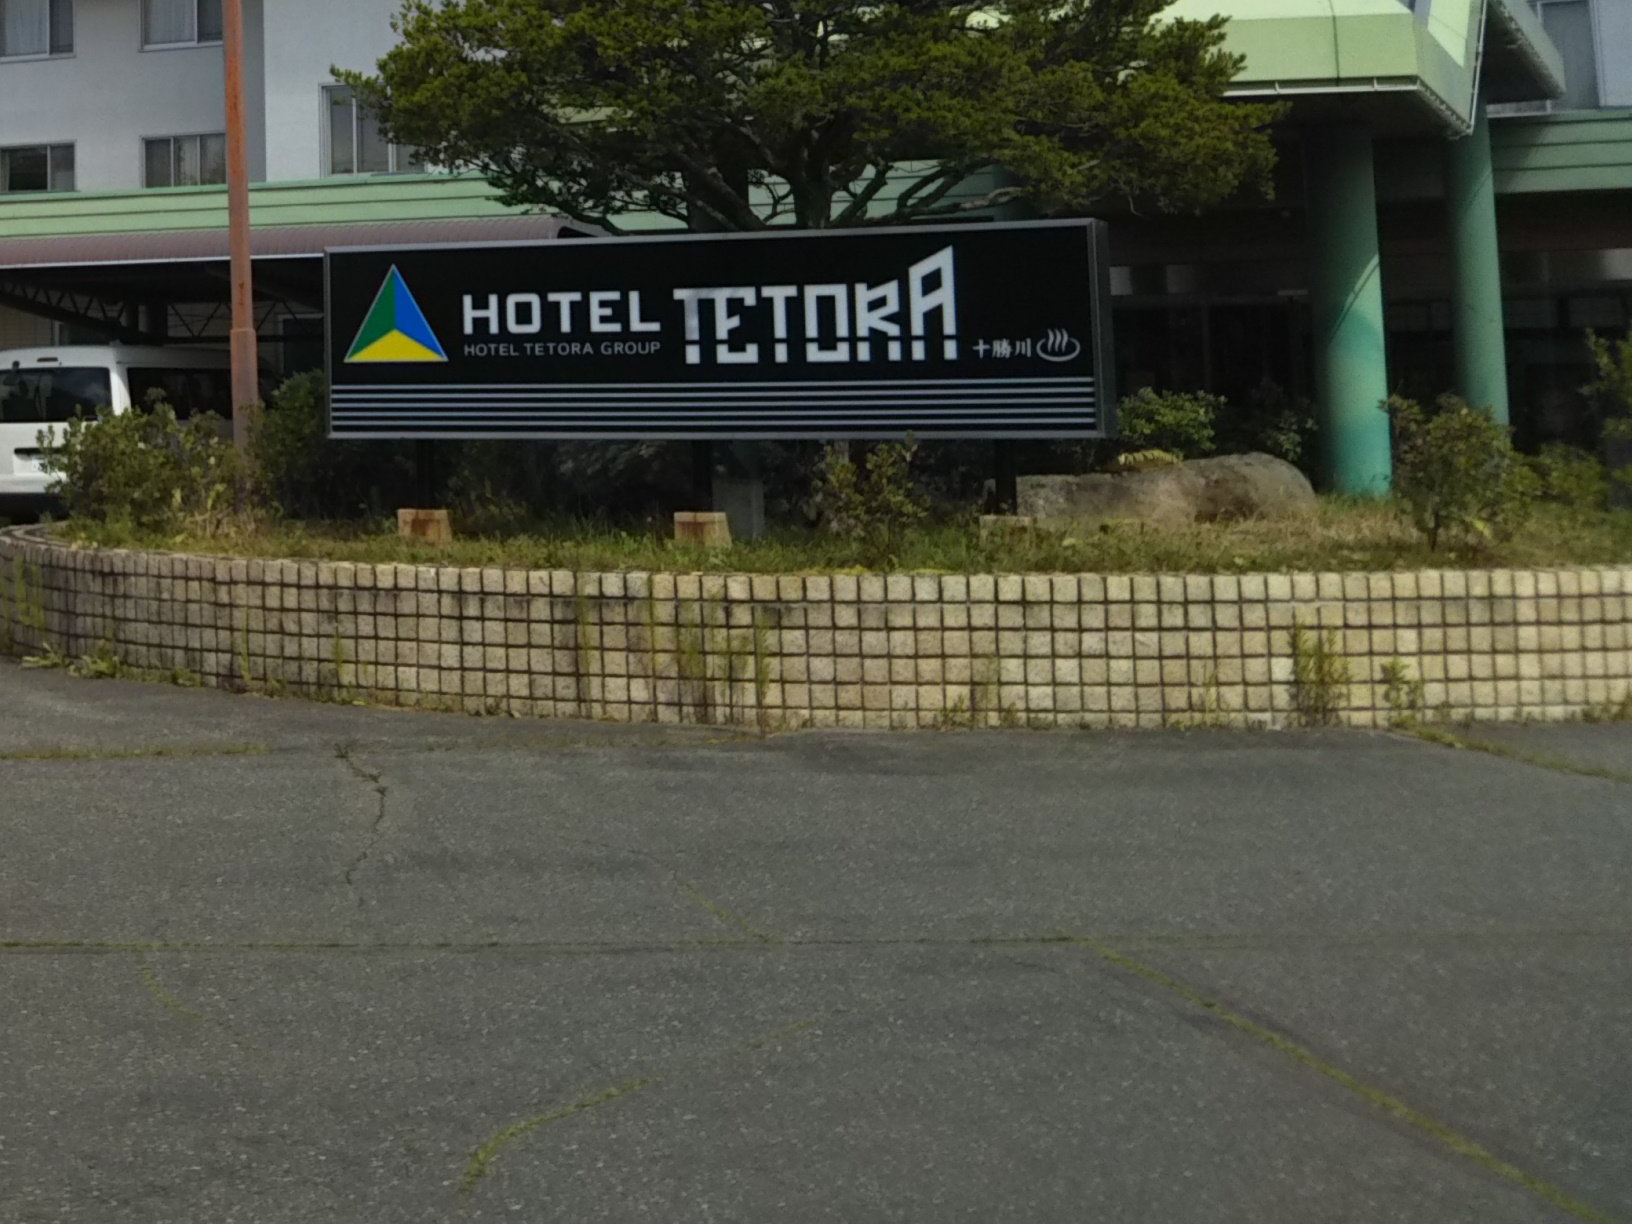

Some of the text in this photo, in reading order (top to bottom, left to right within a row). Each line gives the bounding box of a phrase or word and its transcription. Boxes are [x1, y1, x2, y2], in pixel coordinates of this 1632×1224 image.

[462, 244, 957, 365] HOTEL TETORA
[463, 340, 661, 357] HOTEL TETORA GROUP
[971, 337, 1032, 359] 十勝川
